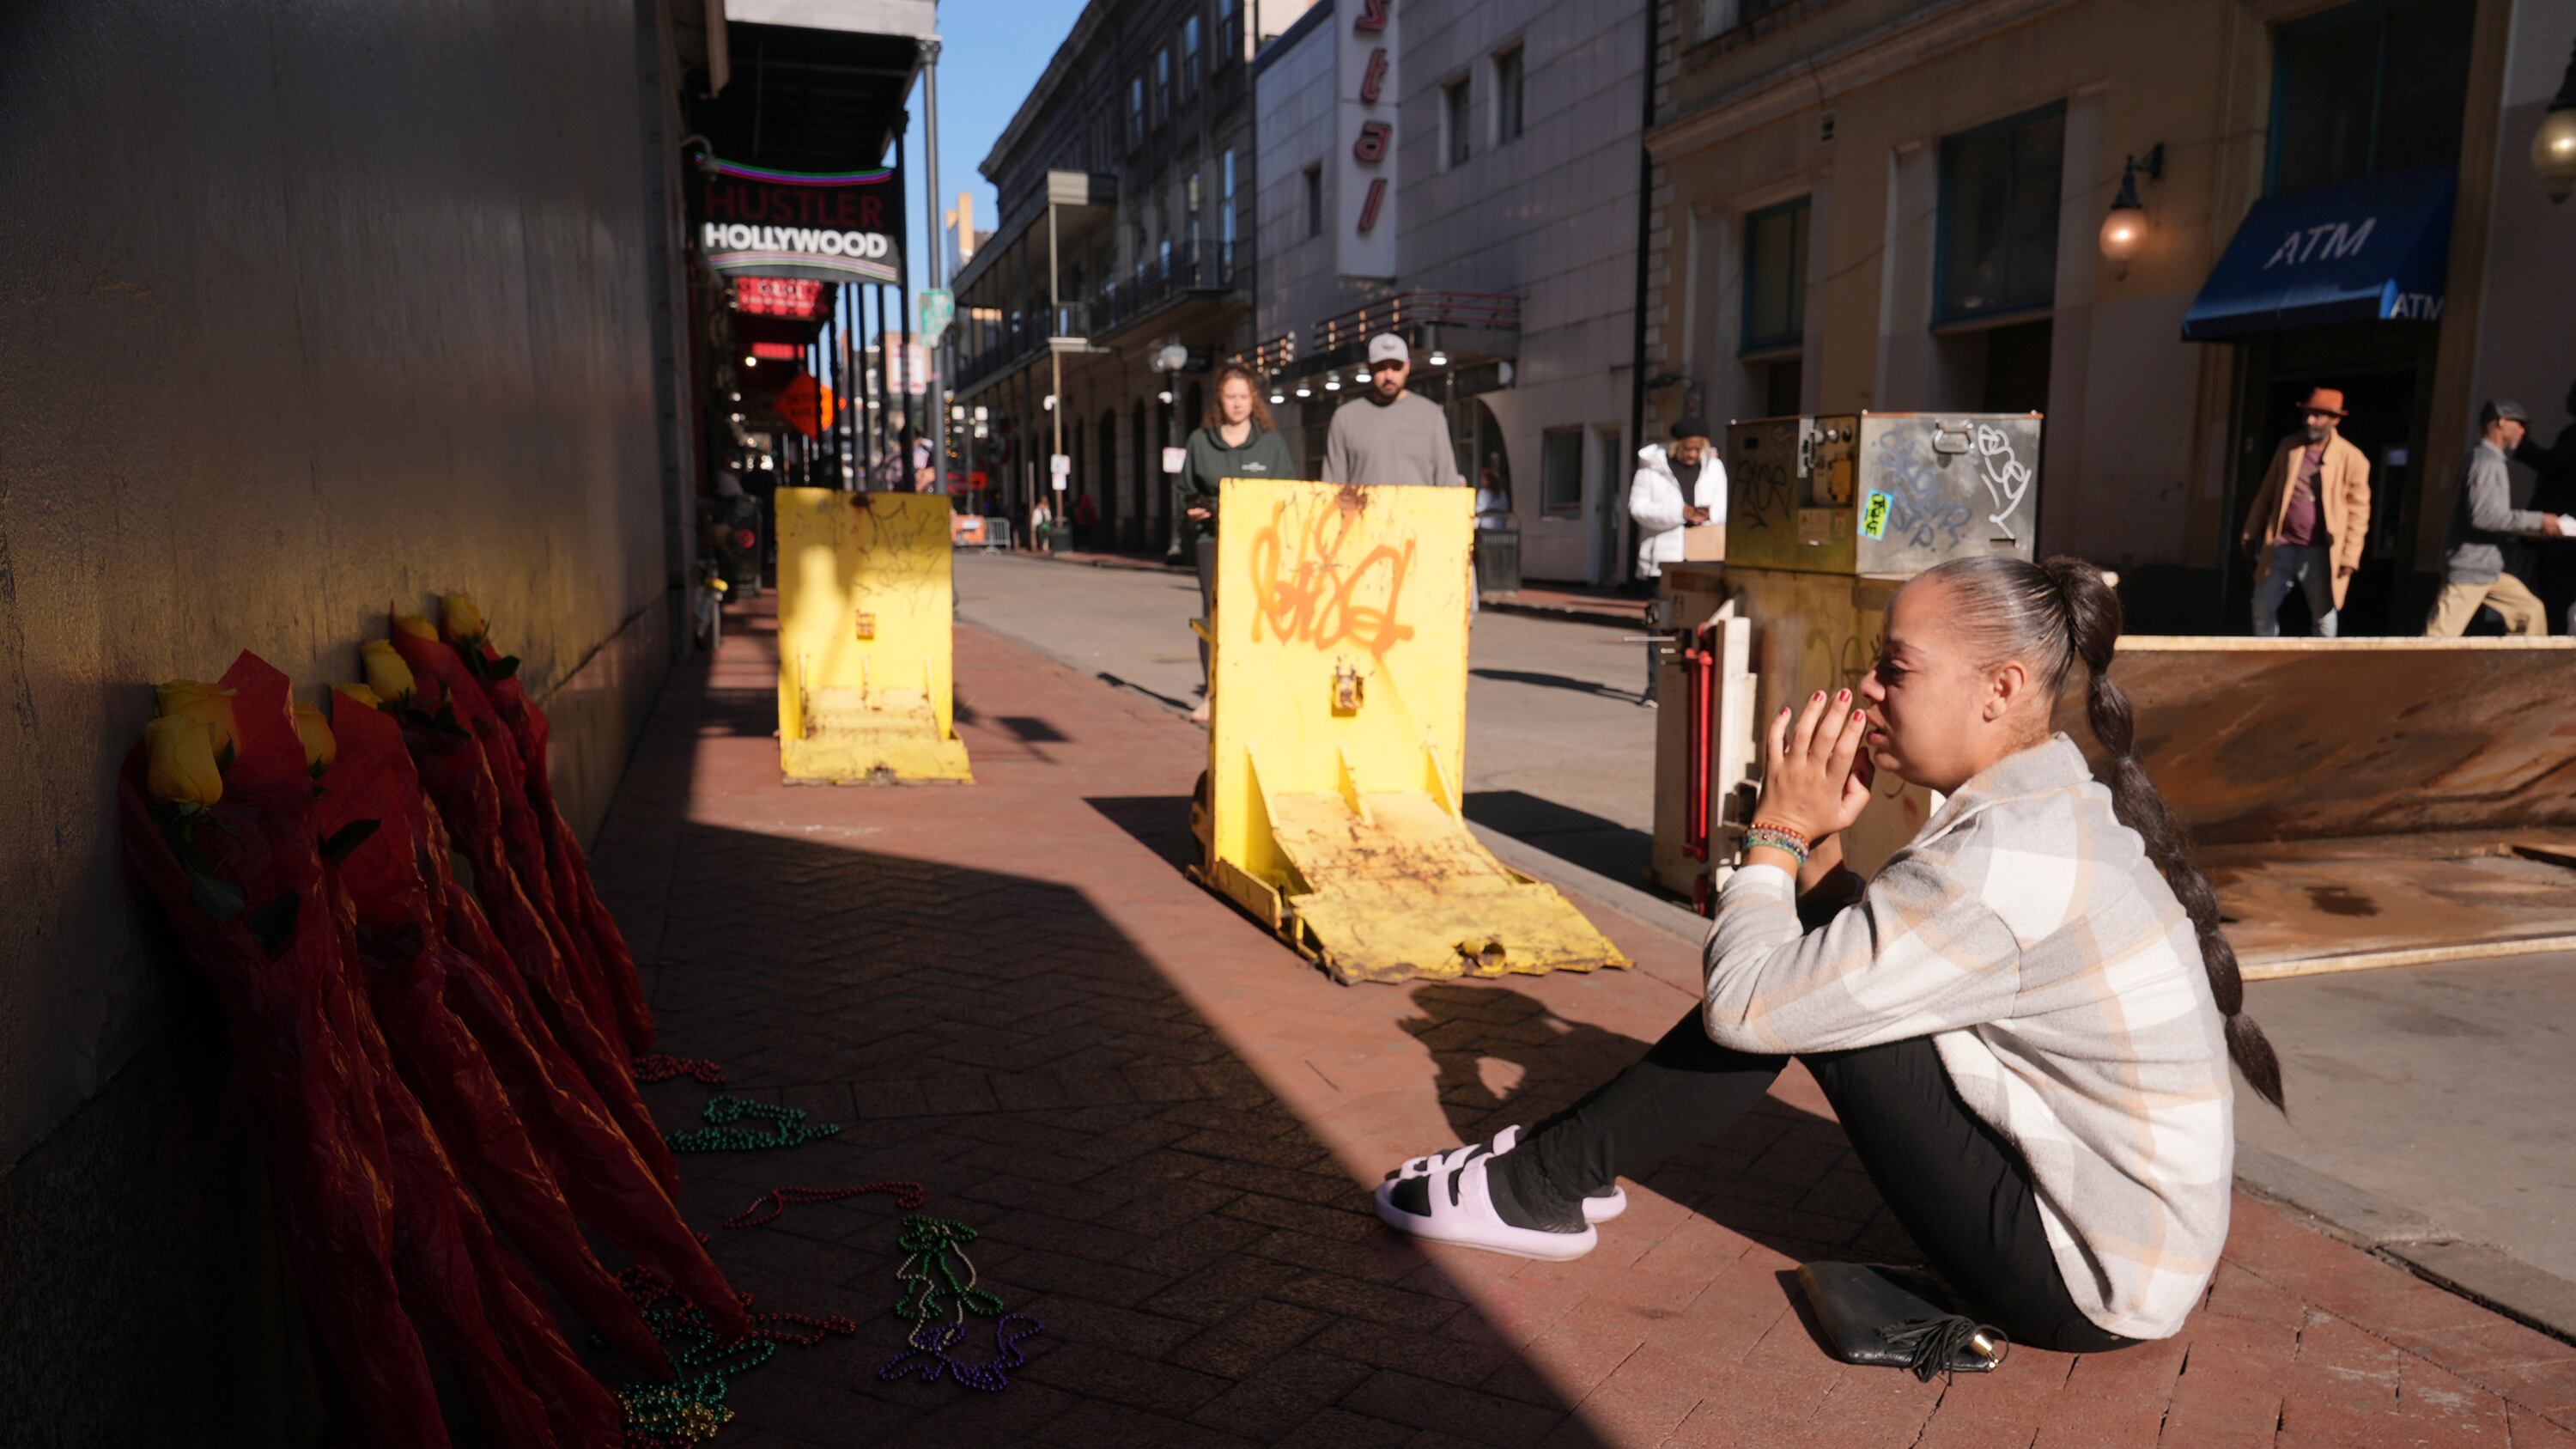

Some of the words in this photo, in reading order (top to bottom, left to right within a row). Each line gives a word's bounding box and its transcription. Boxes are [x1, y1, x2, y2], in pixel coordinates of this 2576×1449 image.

[702, 183, 885, 229] HUSTLER
[704, 222, 889, 259] HOLLYWOOD
[2263, 216, 2378, 271] ATM
